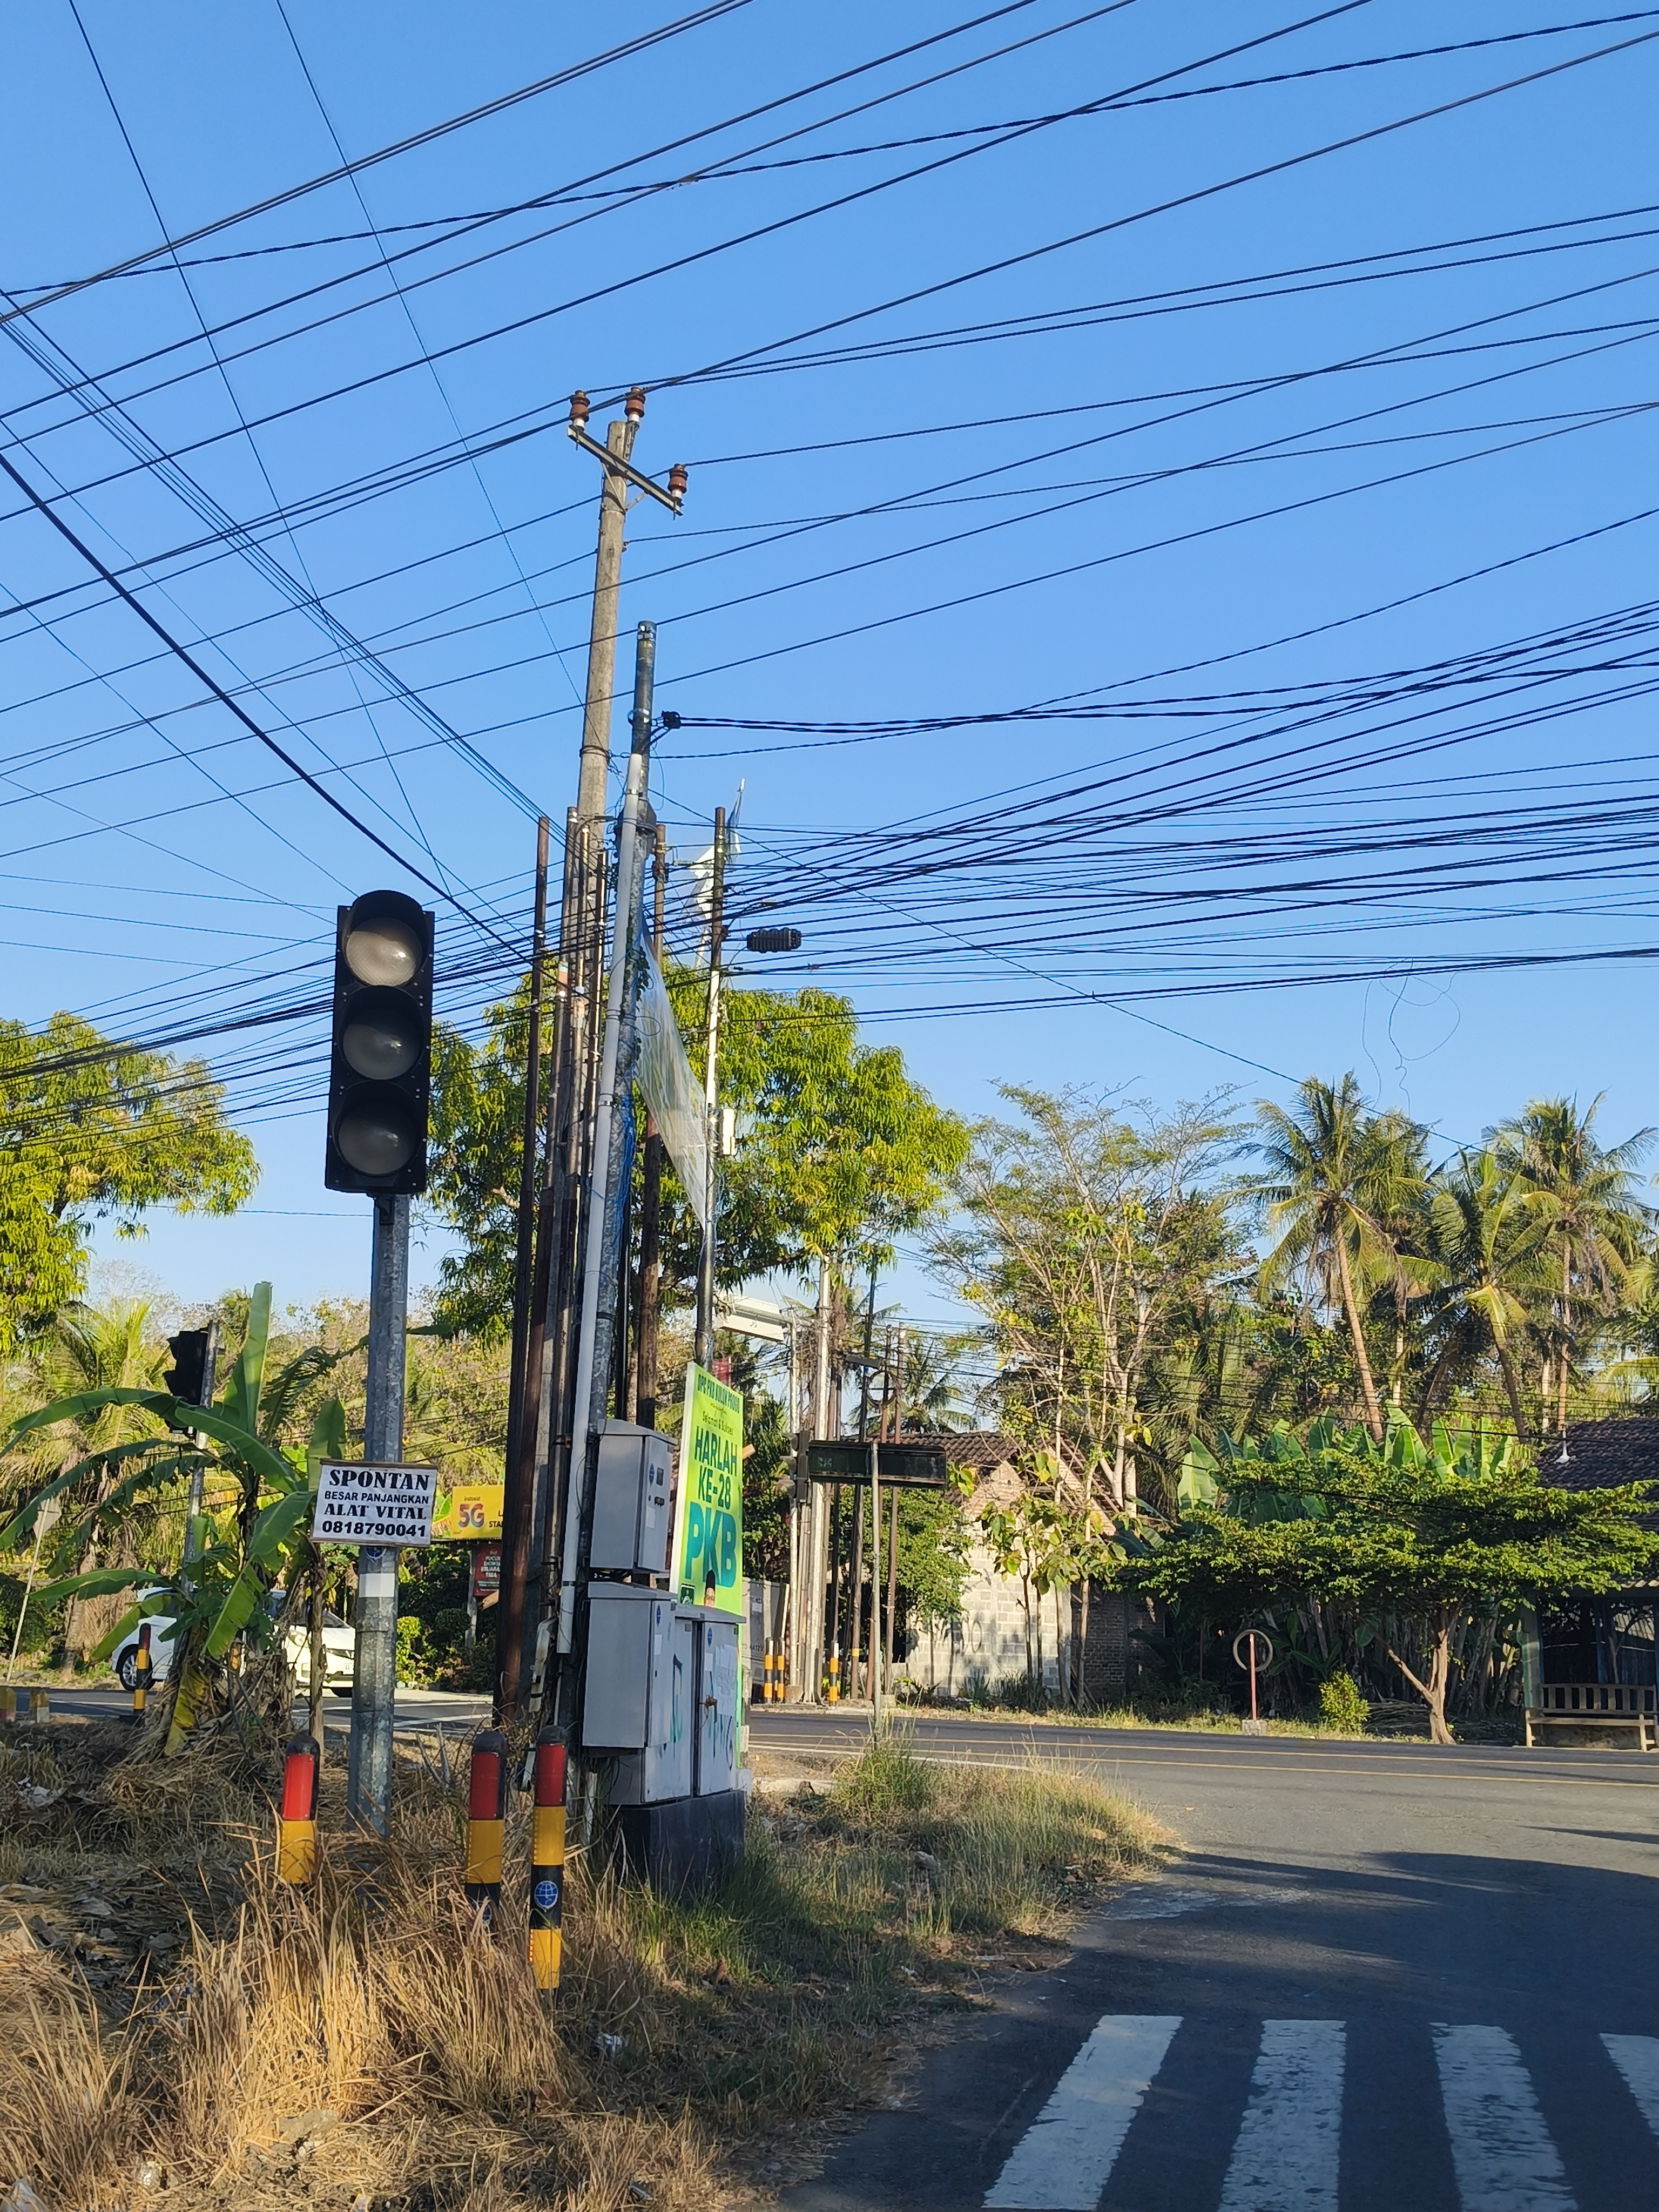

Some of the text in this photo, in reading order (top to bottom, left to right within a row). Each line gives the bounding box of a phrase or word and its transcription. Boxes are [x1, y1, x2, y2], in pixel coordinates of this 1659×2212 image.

[694, 1425, 737, 1476] HARLAH
[329, 1469, 429, 1491] SPONTAN
[698, 1465, 731, 1510] KE-28
[325, 1491, 429, 1504] BESAR PANJANGKAN
[324, 1503, 427, 1520] ALAT VITAL
[458, 1503, 485, 1528] 5G
[322, 1521, 426, 1537] 0818790041
[684, 1501, 736, 1588] PKB
